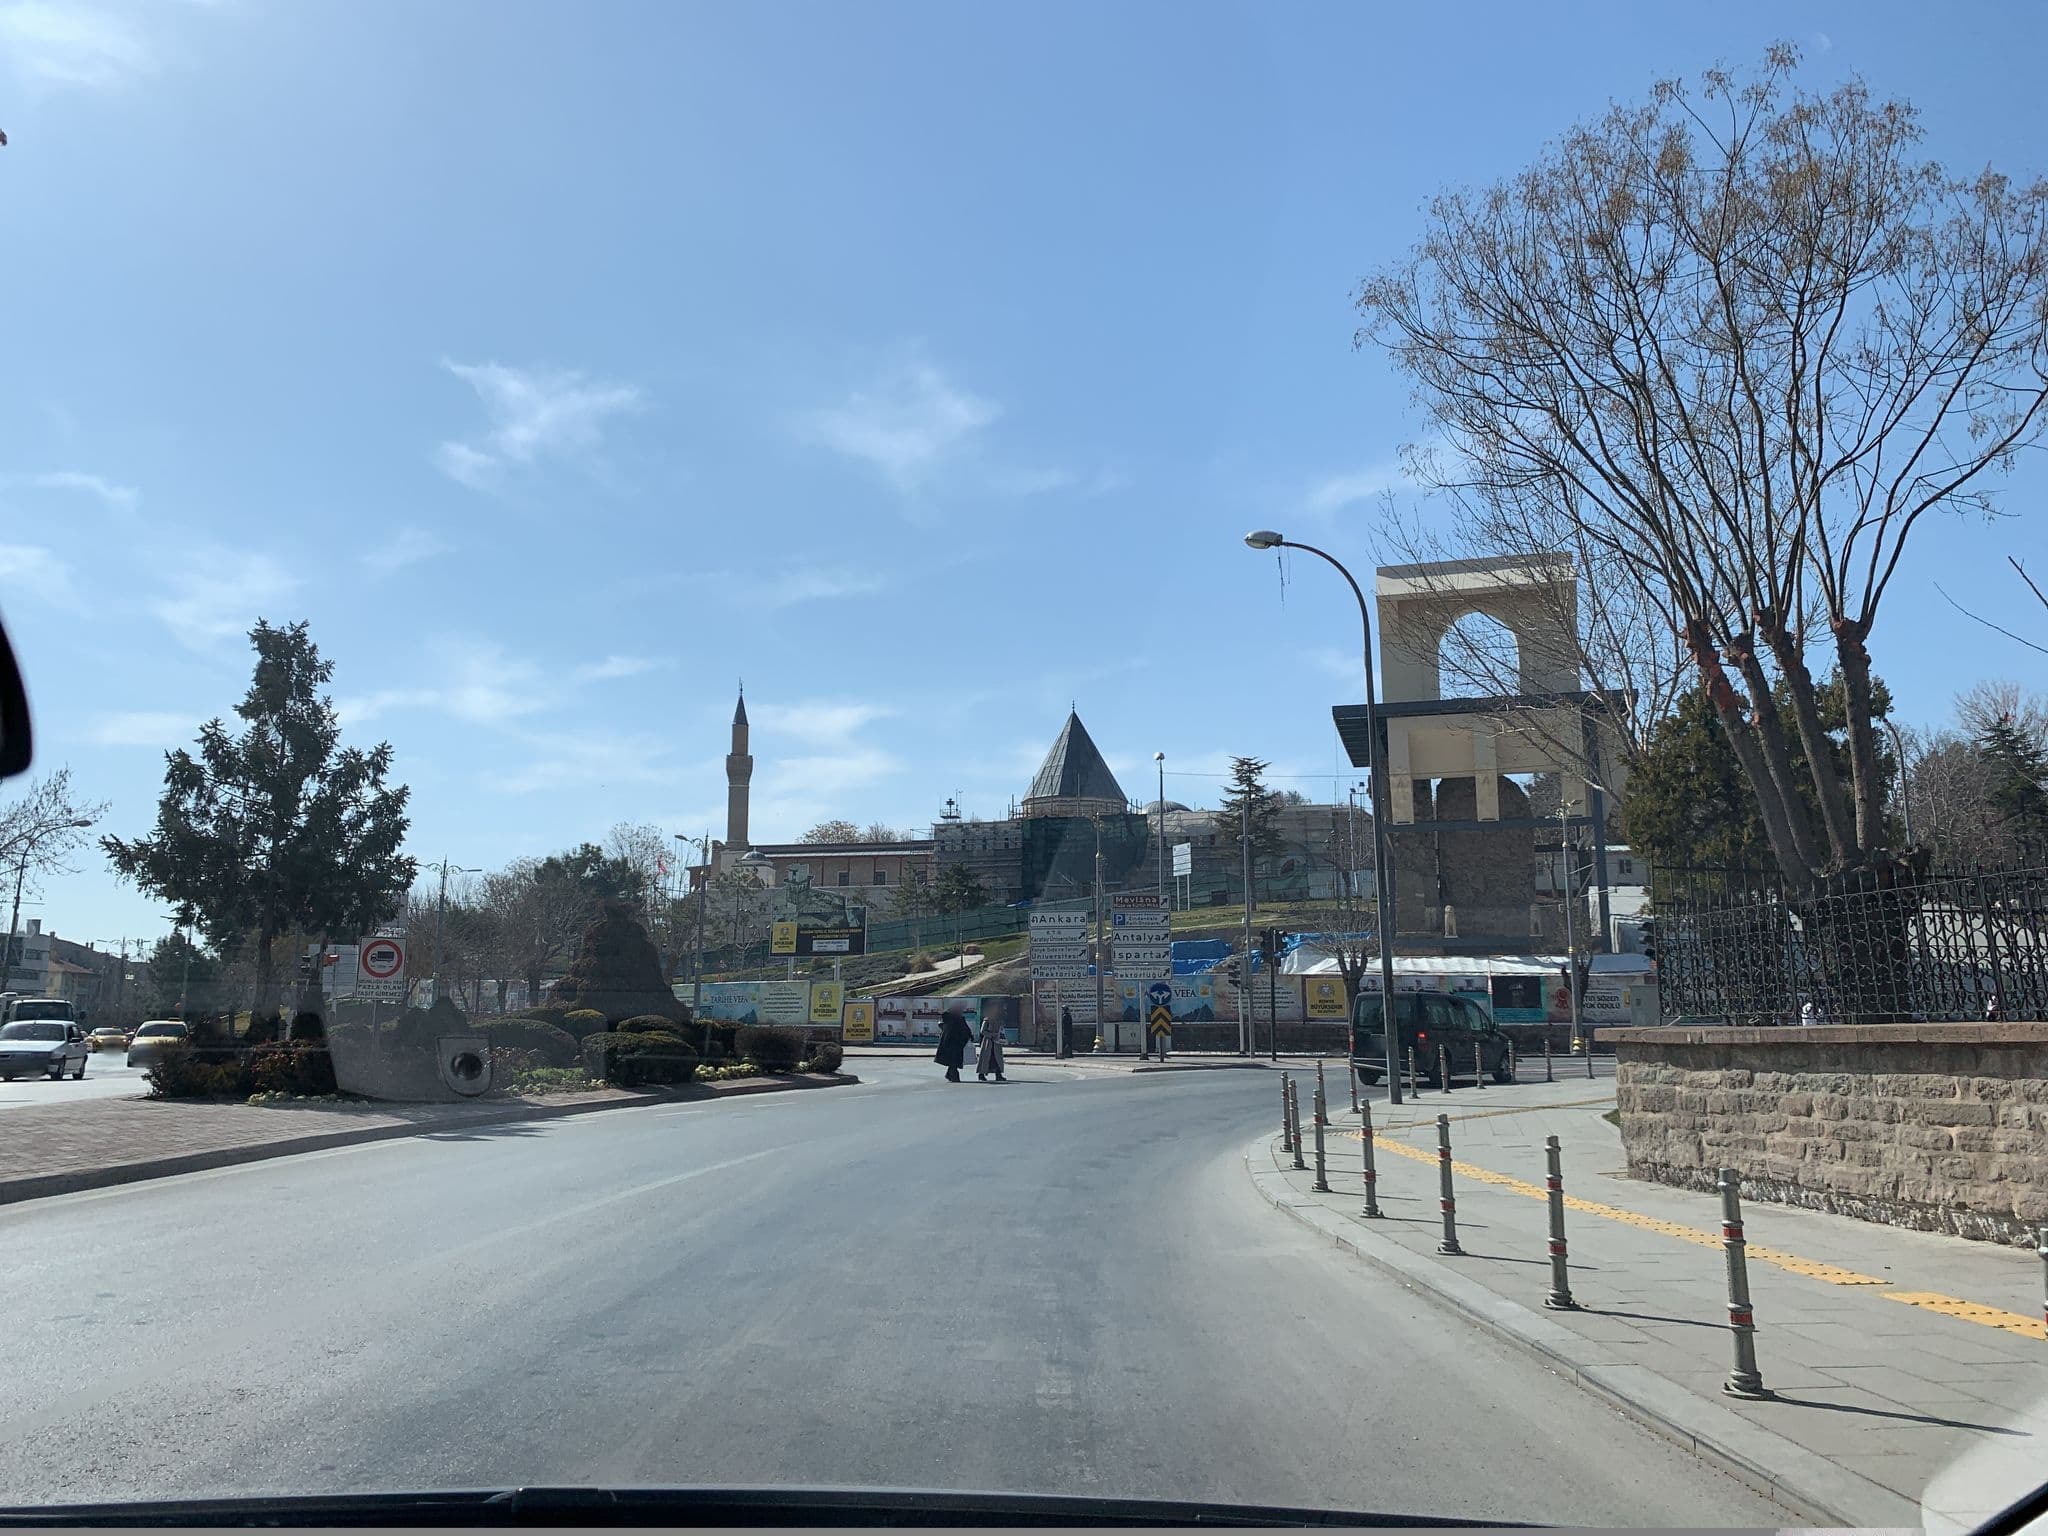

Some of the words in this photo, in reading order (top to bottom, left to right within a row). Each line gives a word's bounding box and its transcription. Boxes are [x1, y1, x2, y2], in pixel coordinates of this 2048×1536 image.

[1040, 915, 1086, 924] Ankara
[1114, 932, 1161, 943] Antalya
[1113, 950, 1162, 960] Isparta
[1174, 989, 1198, 998] VEFA
